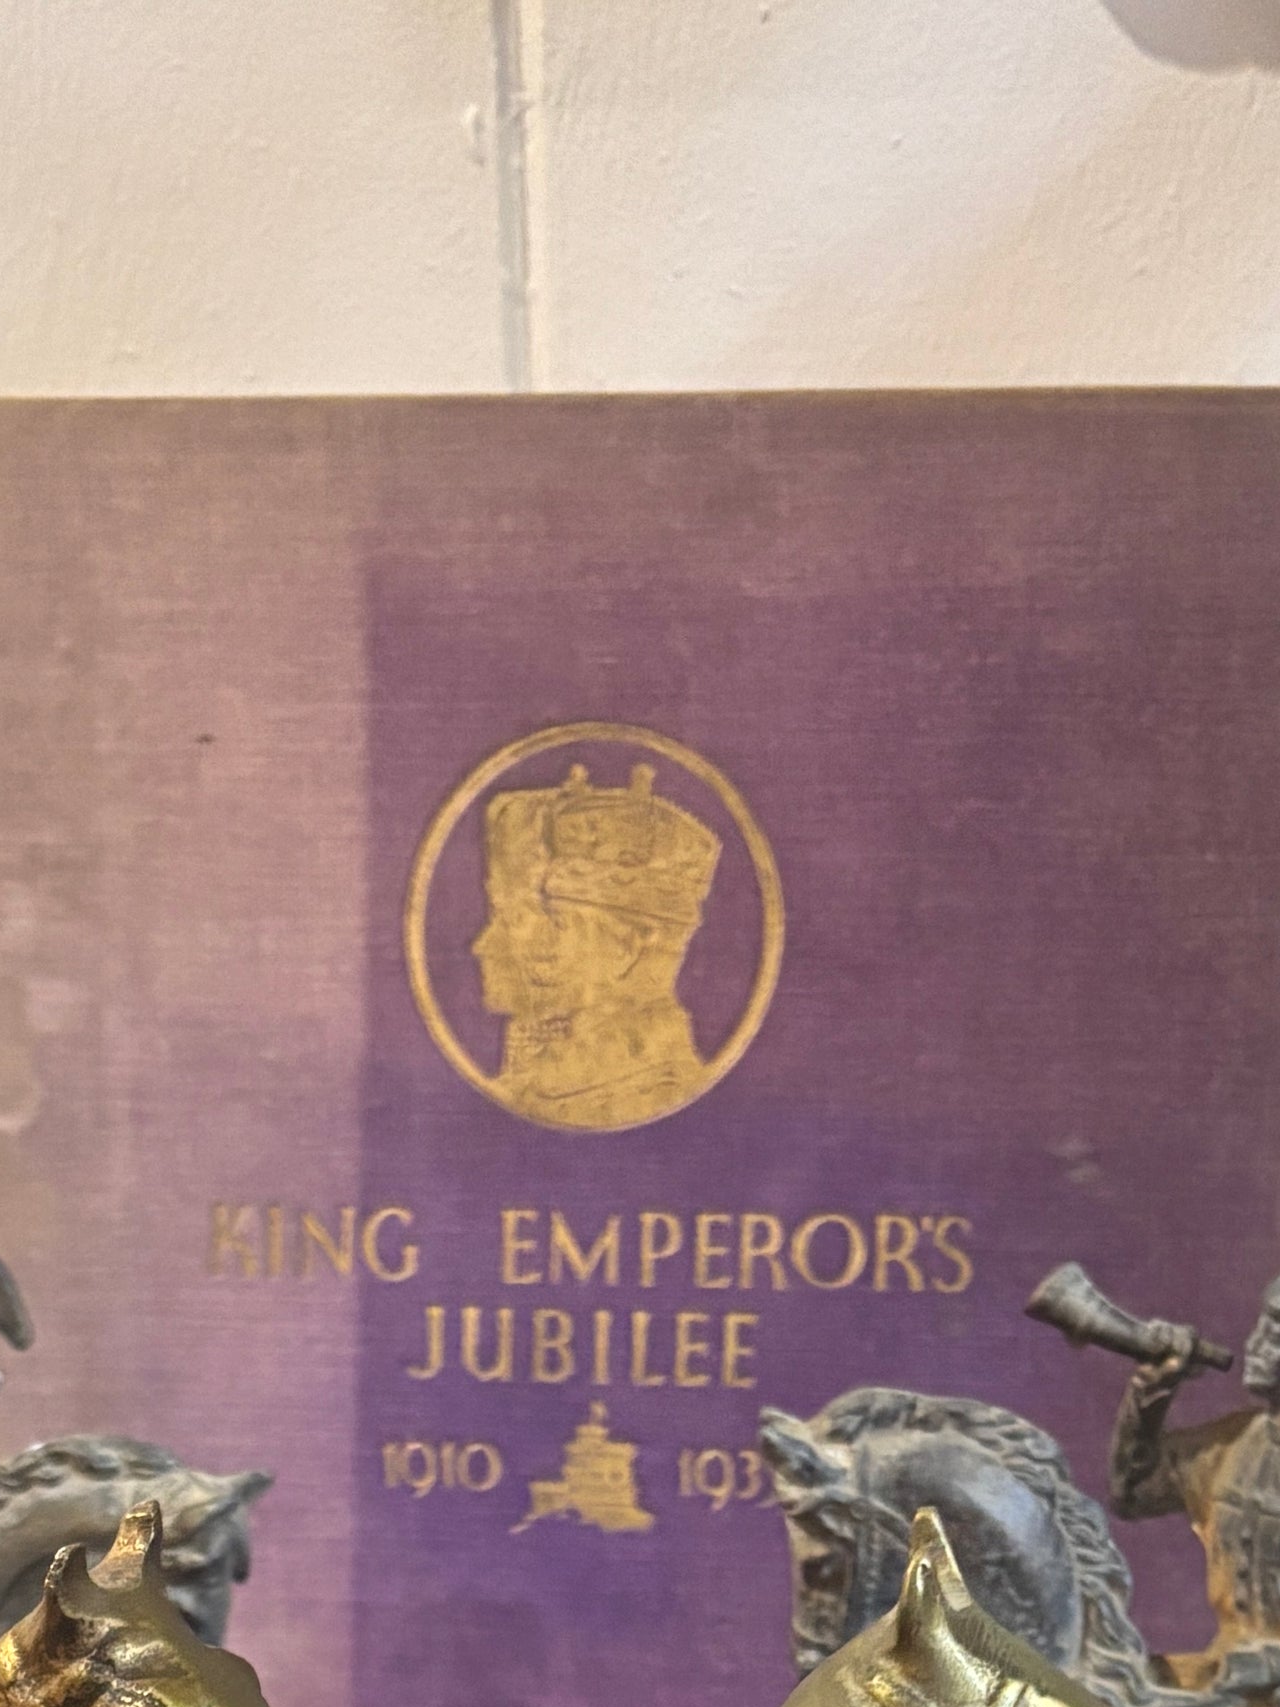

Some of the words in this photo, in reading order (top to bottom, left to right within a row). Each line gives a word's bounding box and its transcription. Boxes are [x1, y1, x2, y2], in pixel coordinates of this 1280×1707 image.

[204, 1203, 421, 1284] KING
[500, 1208, 976, 1295] EMPEROR'S
[406, 1304, 761, 1390] JUBILEE
[382, 1441, 505, 1499] 1910
[677, 1447, 779, 1512] 193
